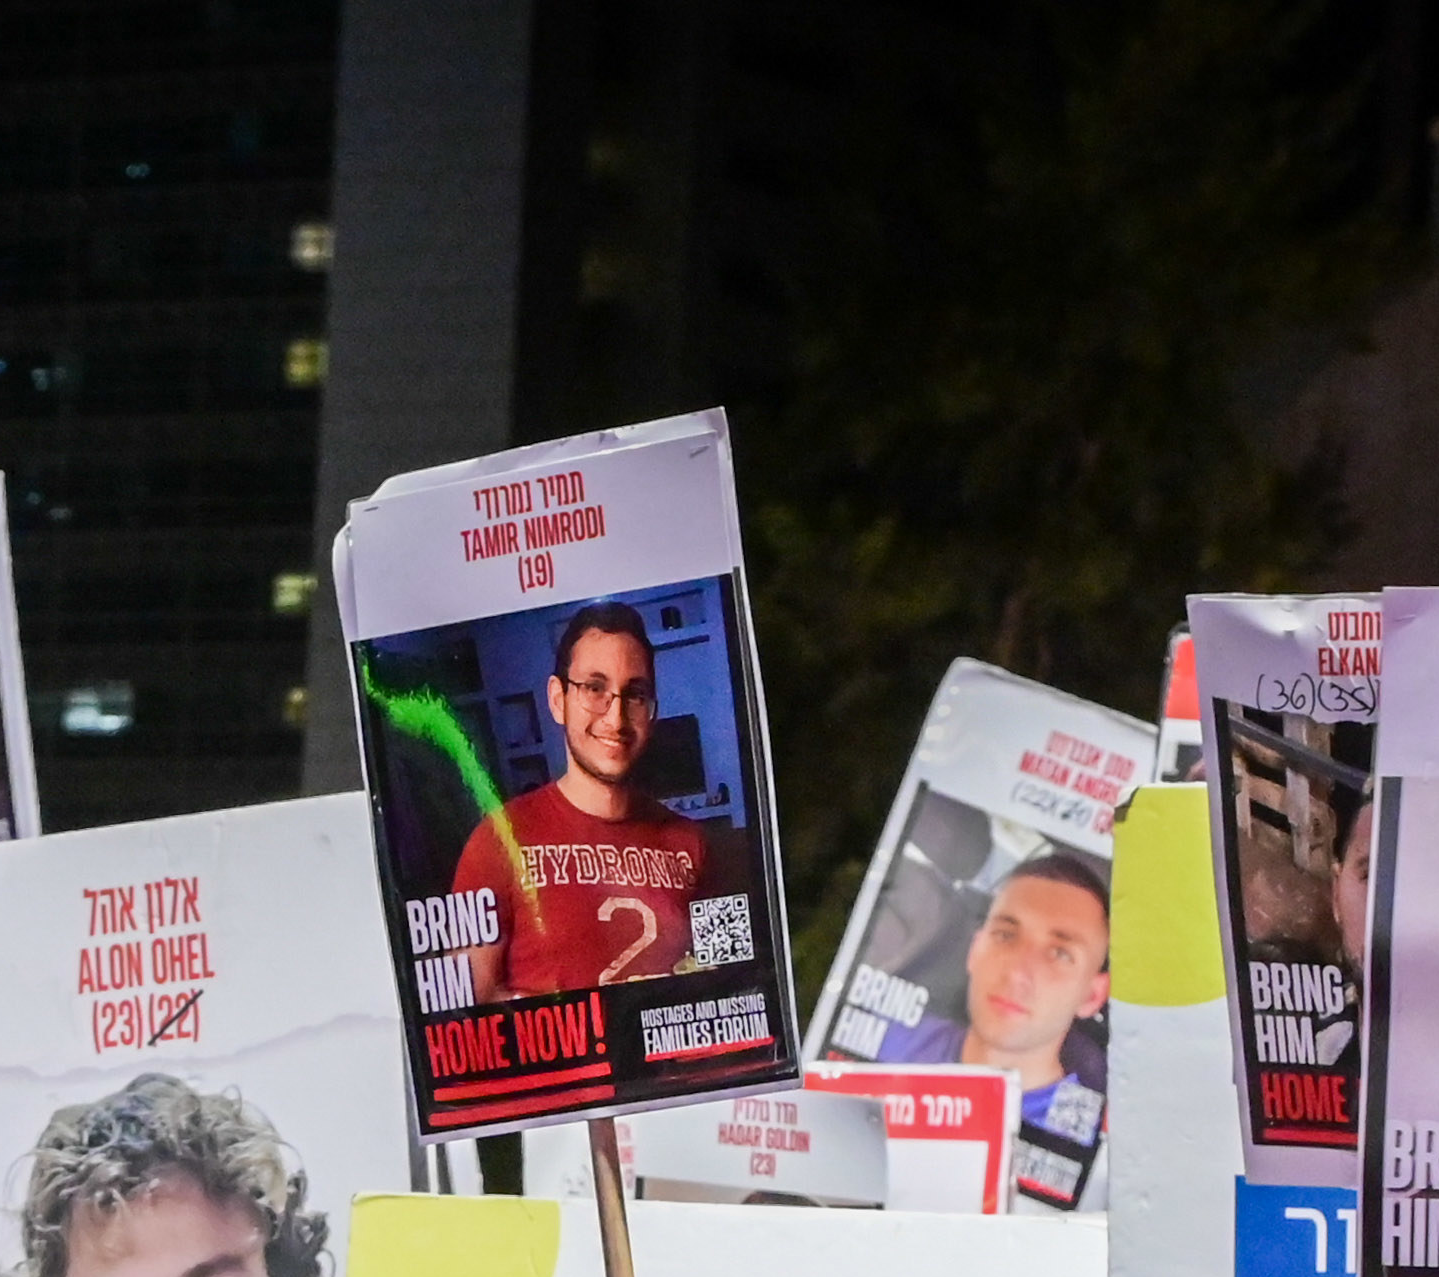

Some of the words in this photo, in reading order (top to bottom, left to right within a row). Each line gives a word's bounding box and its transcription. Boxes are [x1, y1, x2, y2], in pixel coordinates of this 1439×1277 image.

[473, 480, 532, 514] נמרודי
[536, 471, 585, 508] תמיר
[459, 521, 520, 564] TAMIR
[524, 504, 605, 552] NIMRODI
[517, 552, 554, 593] (19)
[83, 888, 137, 937] אהל
[143, 876, 201, 932] אלון
[406, 888, 500, 956] BRING
[78, 942, 143, 995] ALON
[151, 933, 215, 984] OHEL
[598, 896, 656, 986] 2
[414, 955, 474, 1015] HIM
[847, 963, 929, 1025] BRING
[1250, 963, 1345, 1014] BRING
[92, 995, 143, 1055] (23)
[425, 1009, 512, 1078] HOME
[515, 992, 605, 1064] NOW!
[643, 1020, 712, 1055] FAMILIES
[716, 1012, 771, 1045] FORUM
[832, 1007, 888, 1060] HIM
[1253, 1014, 1316, 1065] HIM
[1262, 1072, 1349, 1124] HOME
